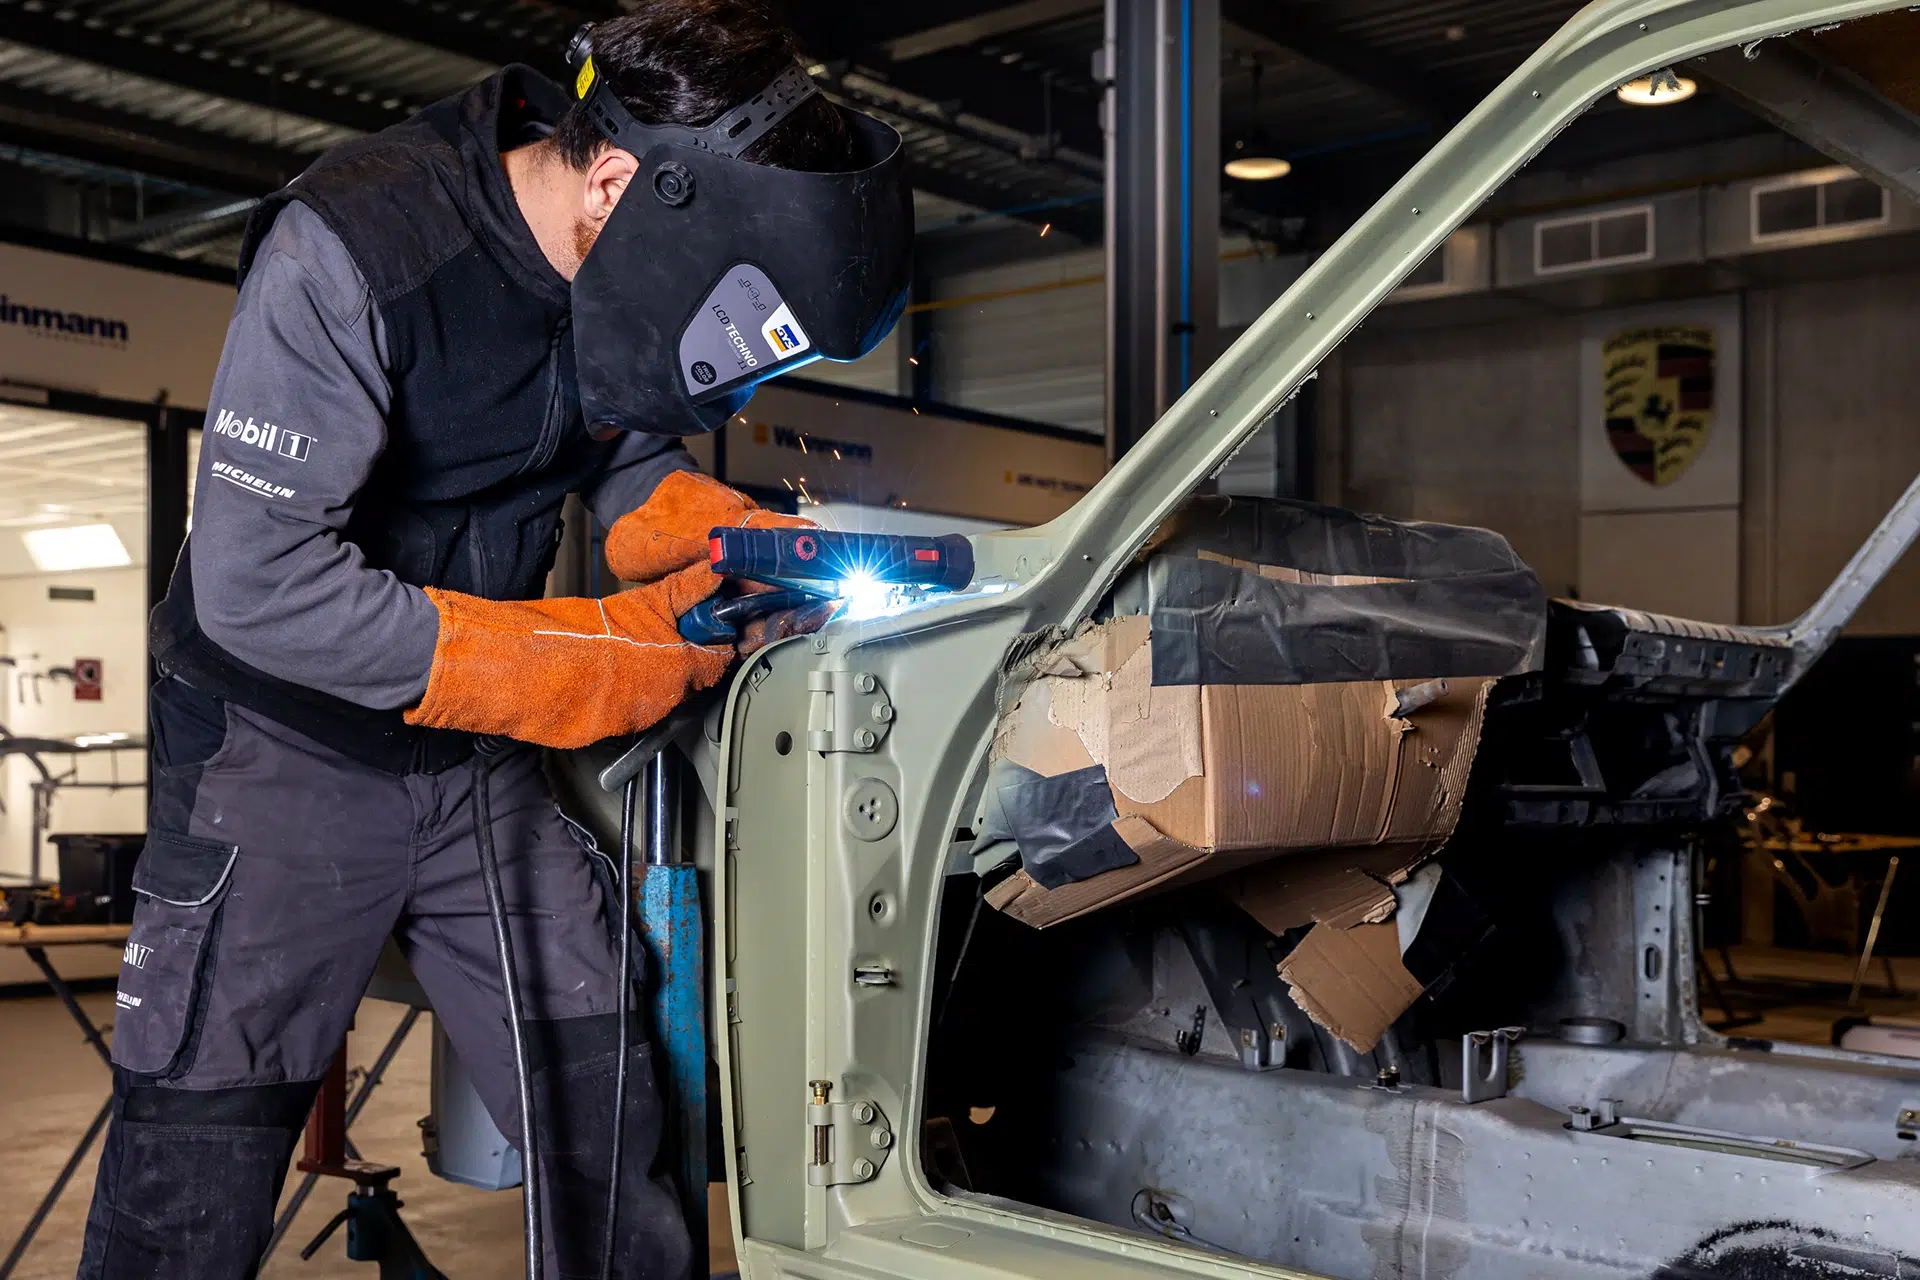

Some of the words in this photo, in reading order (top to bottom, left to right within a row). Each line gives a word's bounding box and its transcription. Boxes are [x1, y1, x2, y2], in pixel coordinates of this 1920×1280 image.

[0, 294, 129, 342] inmann
[711, 304, 730, 325] LCD
[725, 323, 758, 367] TECHNO
[776, 326, 795, 350] GYS
[695, 364, 709, 383] COLOR
[701, 363, 713, 379] TRUE
[212, 408, 278, 452] Mobil
[211, 461, 296, 499] MICHELIN
[123, 942, 139, 966] bil
[117, 990, 142, 1007] HELIN
